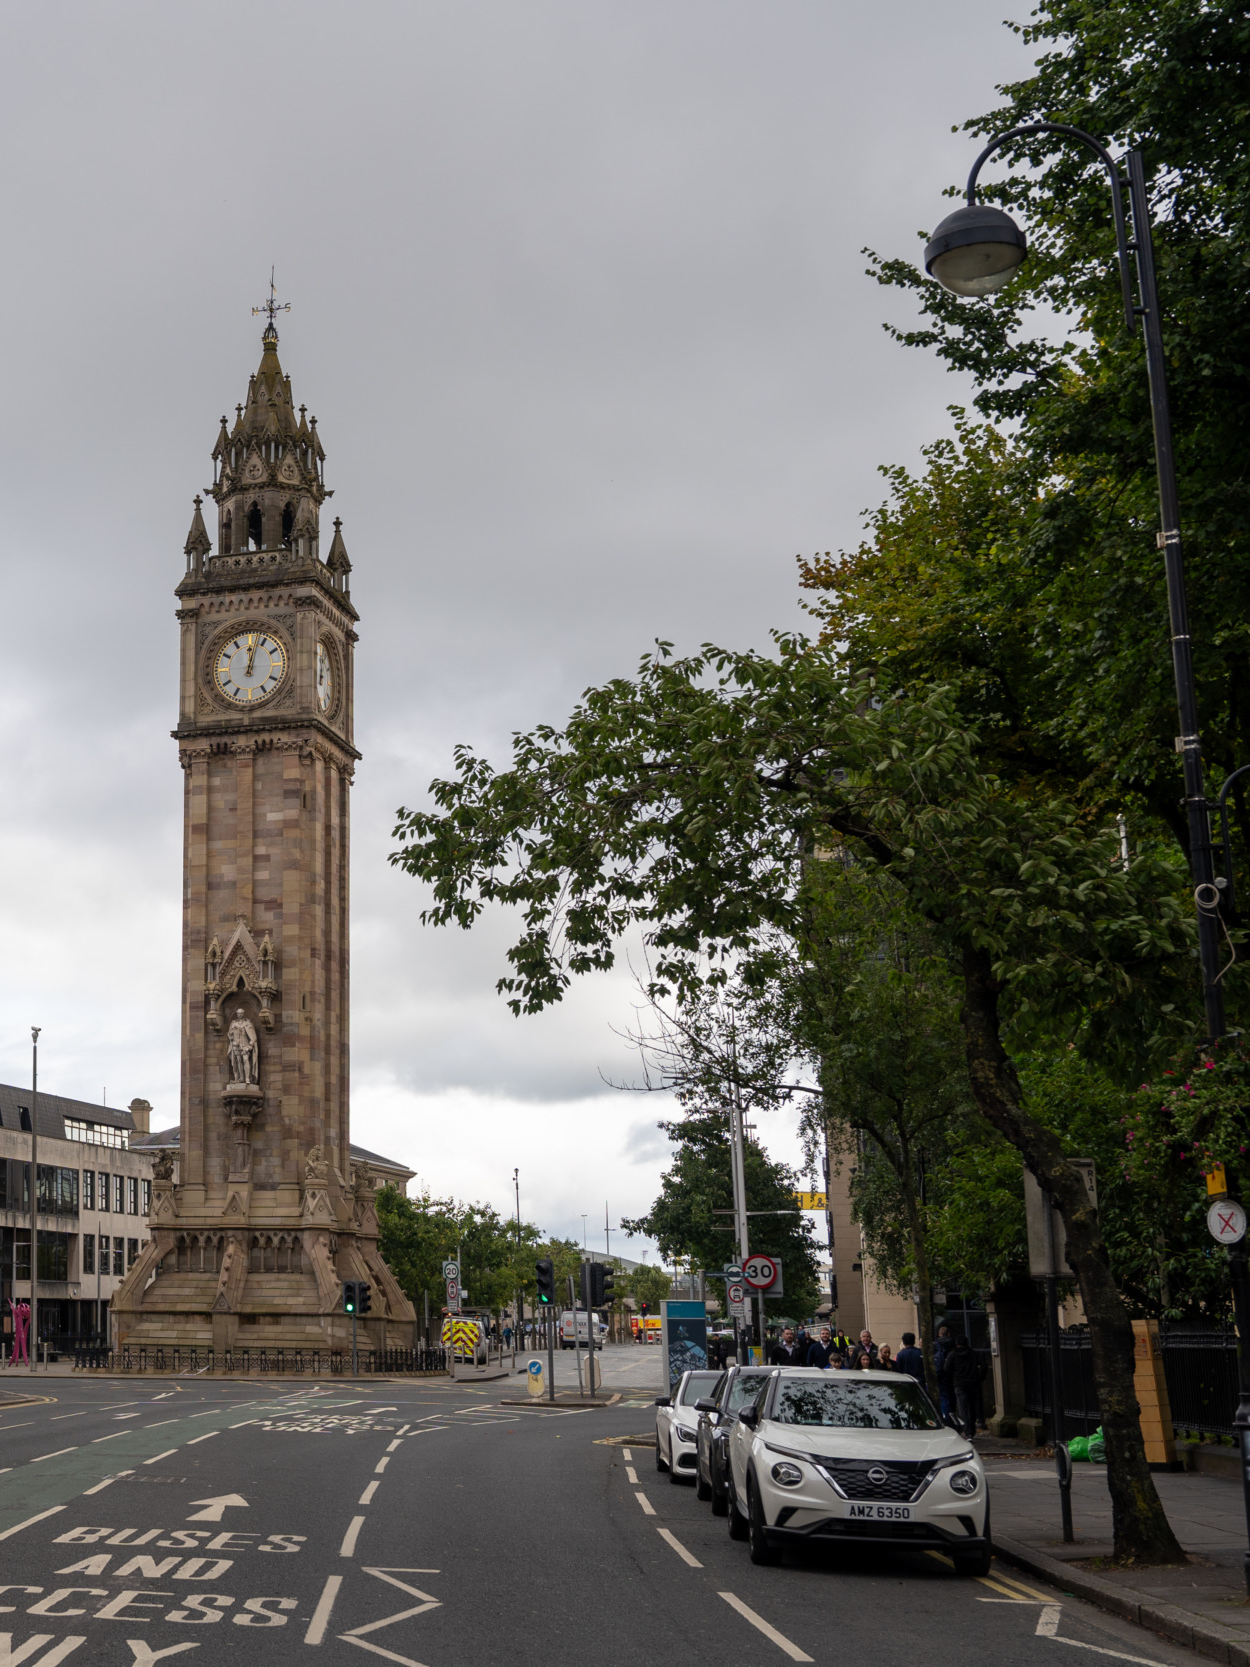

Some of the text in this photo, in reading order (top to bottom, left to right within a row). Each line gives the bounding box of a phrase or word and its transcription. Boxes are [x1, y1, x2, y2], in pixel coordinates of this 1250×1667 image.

[446, 1267, 457, 1275] 20
[748, 1265, 772, 1278] 30
[849, 1505, 910, 1519] AMZ 6350
[51, 1526, 308, 1553] BUSES
[53, 1554, 235, 1581] AND
